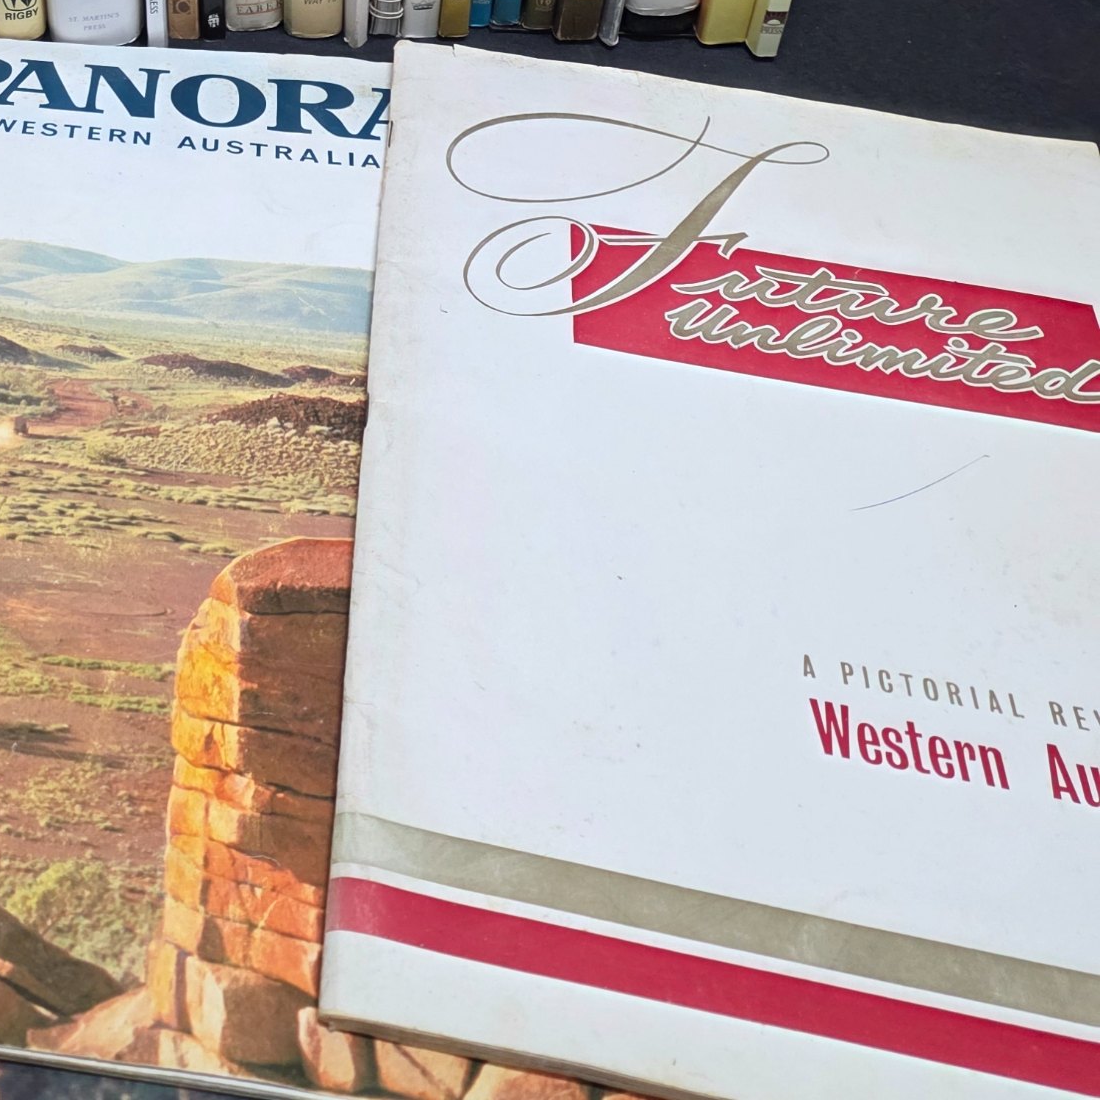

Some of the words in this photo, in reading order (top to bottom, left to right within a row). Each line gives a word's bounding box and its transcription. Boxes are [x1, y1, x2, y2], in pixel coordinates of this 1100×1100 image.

[5, 8, 38, 21] RIGBY
[178, 135, 382, 169] AUSTRALIA
[446, 111, 1045, 340] Future
[665, 298, 1100, 406] Unlimited
[803, 654, 816, 679] A
[840, 661, 1025, 719] PICTORIAL
[809, 697, 1010, 790] Western
